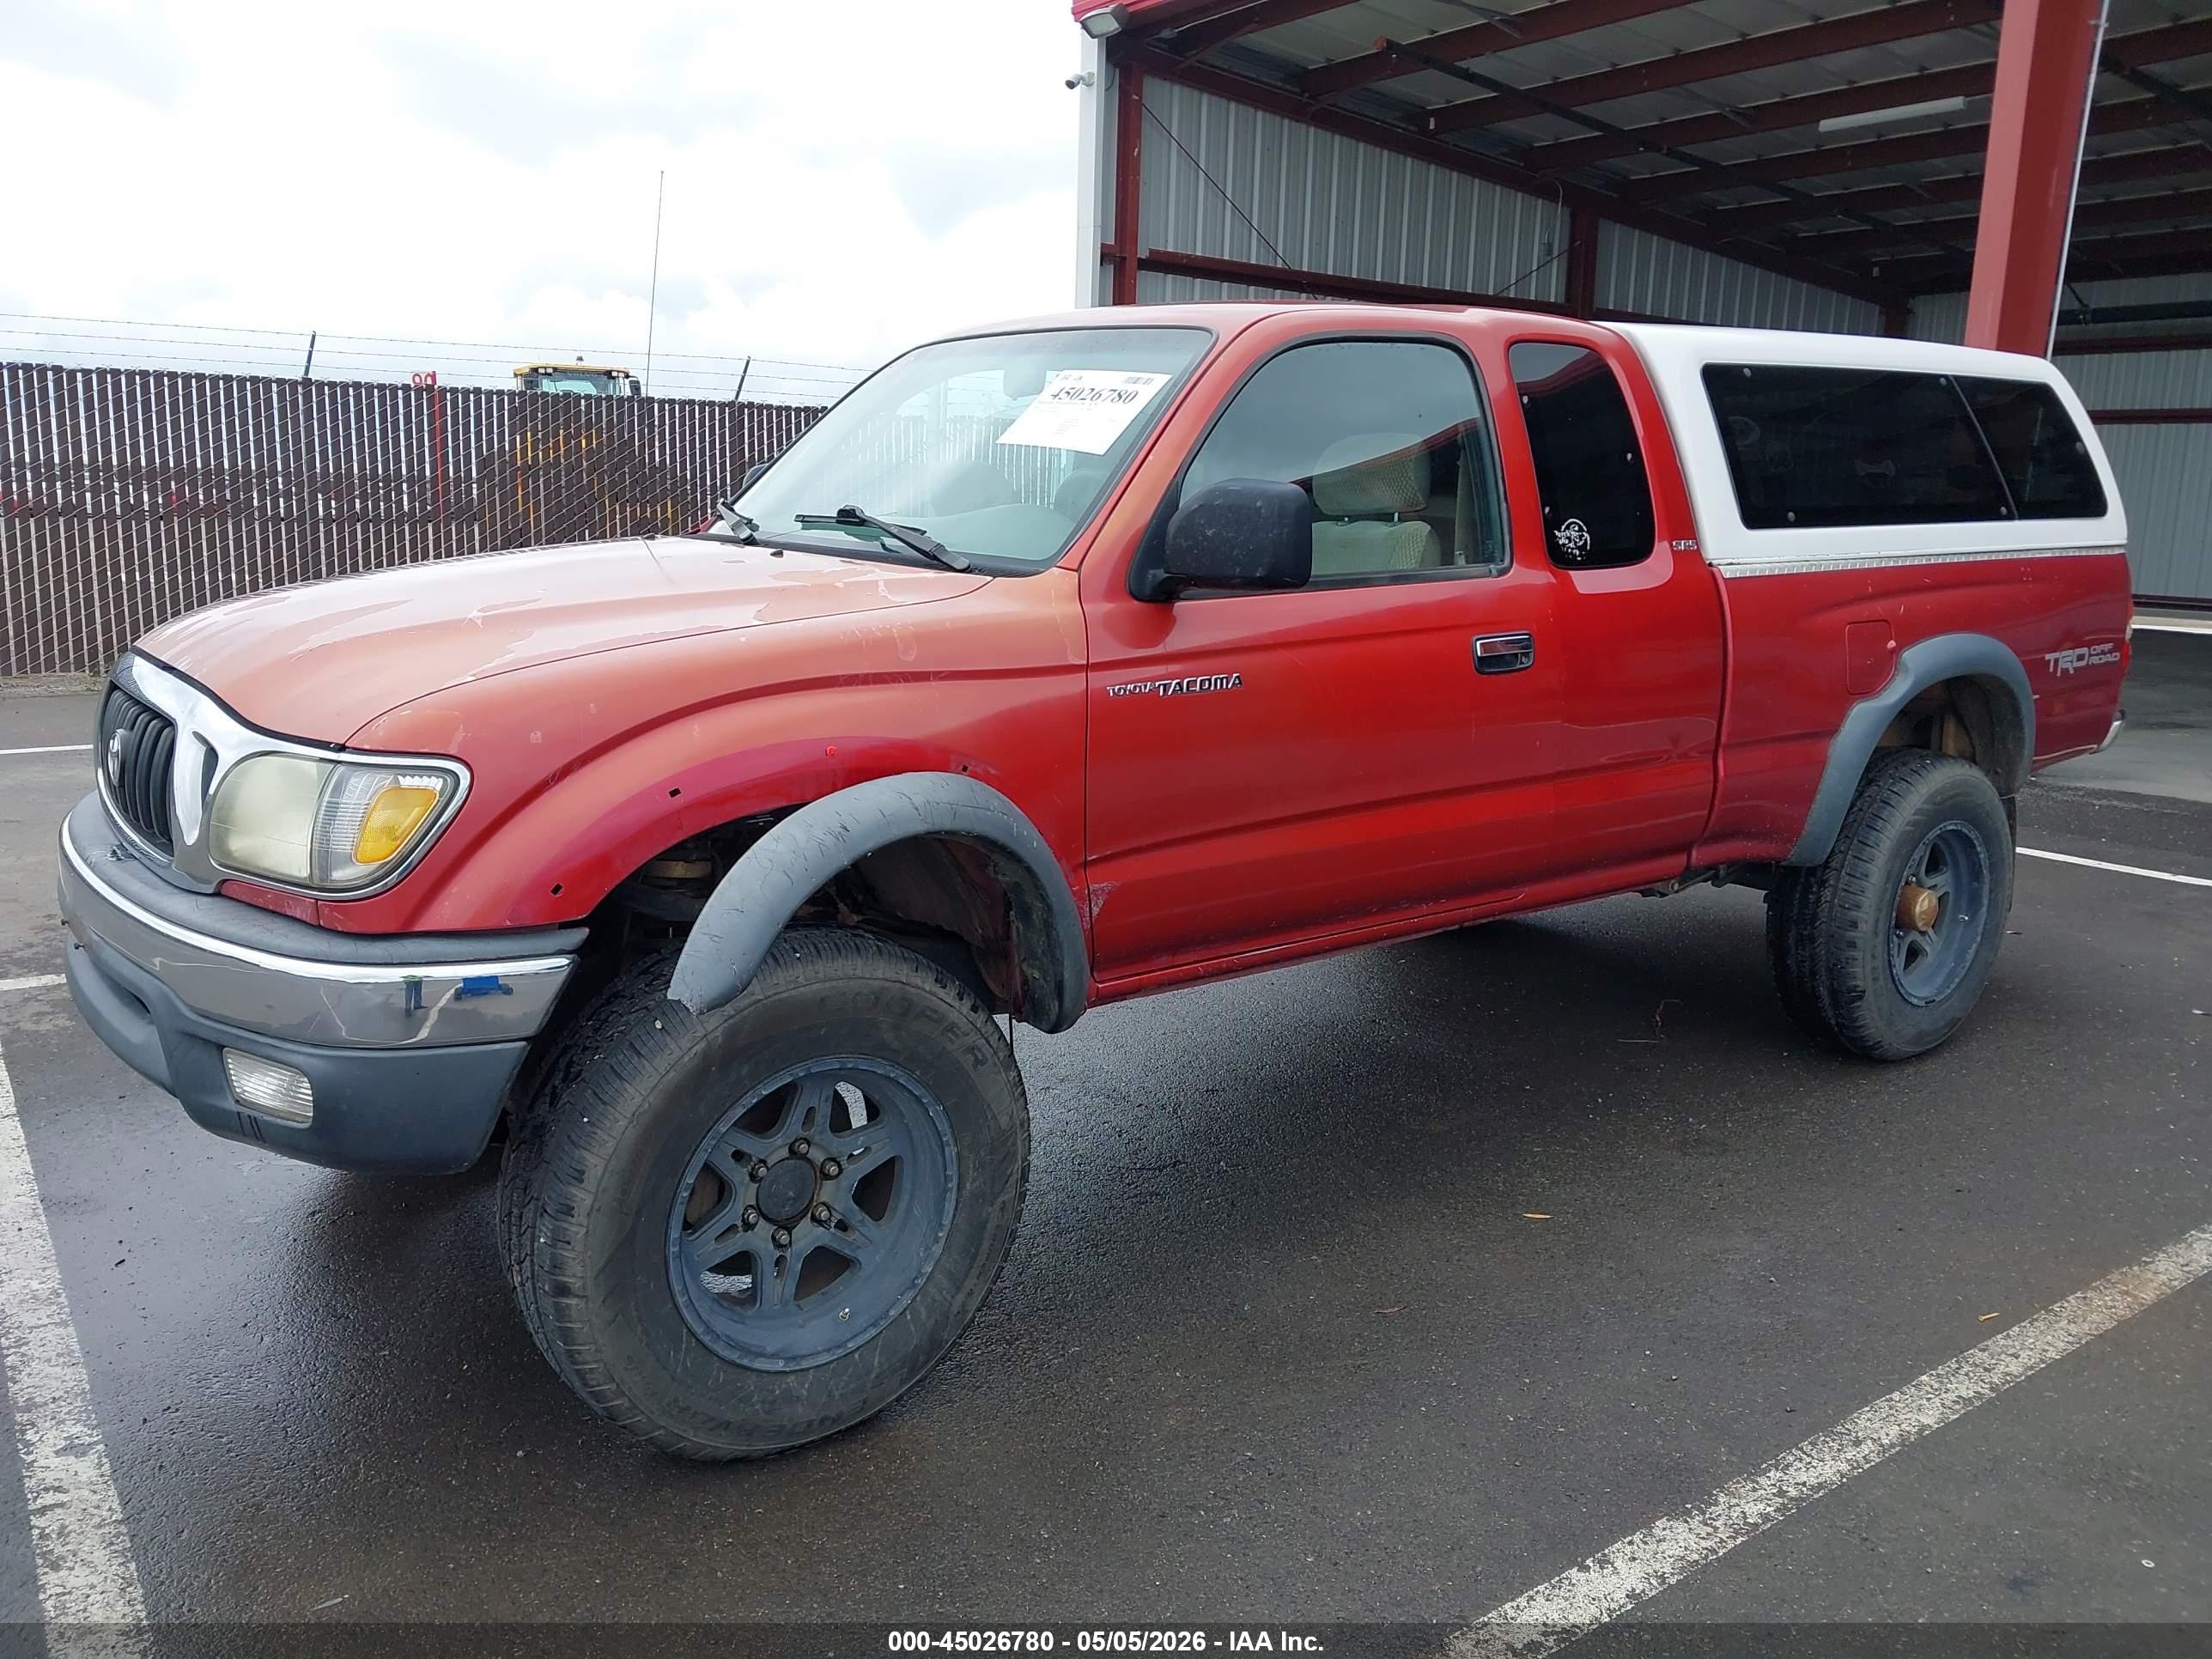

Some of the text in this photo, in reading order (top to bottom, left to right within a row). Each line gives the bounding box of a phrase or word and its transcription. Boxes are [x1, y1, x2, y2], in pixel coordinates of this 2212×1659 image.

[1050, 386, 1139, 404] 45026780
[2045, 642, 2114, 677] TRD OFF
[2088, 653, 2120, 665] ROAD
[1106, 673, 1243, 697] TOYOTA TACOMA
[817, 988, 990, 1073] COOPER
